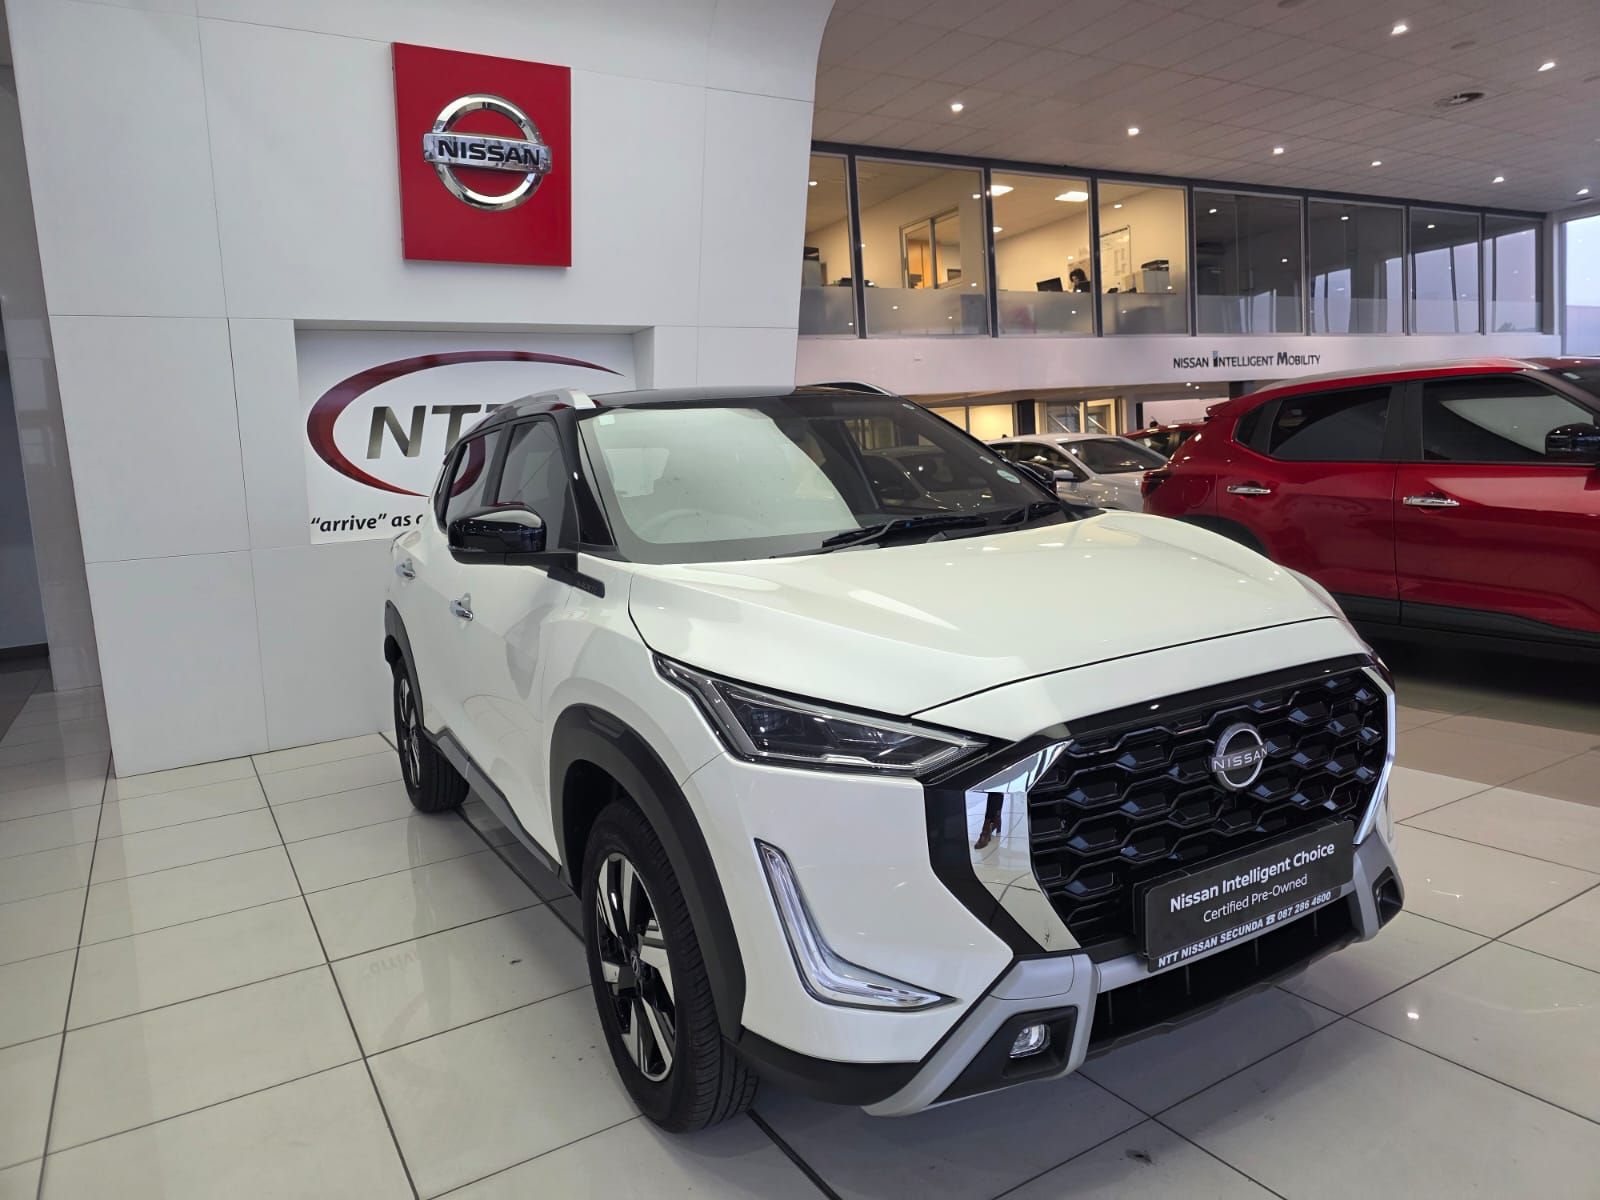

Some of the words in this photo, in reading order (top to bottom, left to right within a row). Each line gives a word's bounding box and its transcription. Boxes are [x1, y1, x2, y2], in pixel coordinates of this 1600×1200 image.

[437, 139, 540, 166] NISSAN
[1173, 357, 1209, 369] NISSAN
[1212, 350, 1274, 368] INTELLIGENT
[1276, 352, 1321, 366] MOBILITY
[366, 403, 504, 460] NT
[391, 514, 411, 527] as
[1214, 746, 1268, 770] NISSAN
[1170, 885, 1219, 913] Nissan
[1222, 857, 1291, 892] Intelligent
[1293, 842, 1335, 867] Choice
[1203, 899, 1249, 923] Certified
[1251, 874, 1308, 905] Pre-Owned
[1158, 951, 1179, 968] NTT
[1181, 936, 1218, 958] NISSAN
[1220, 919, 1264, 944] SECUNDA
[1277, 906, 1293, 921] 087
[1294, 899, 1310, 914] 286
